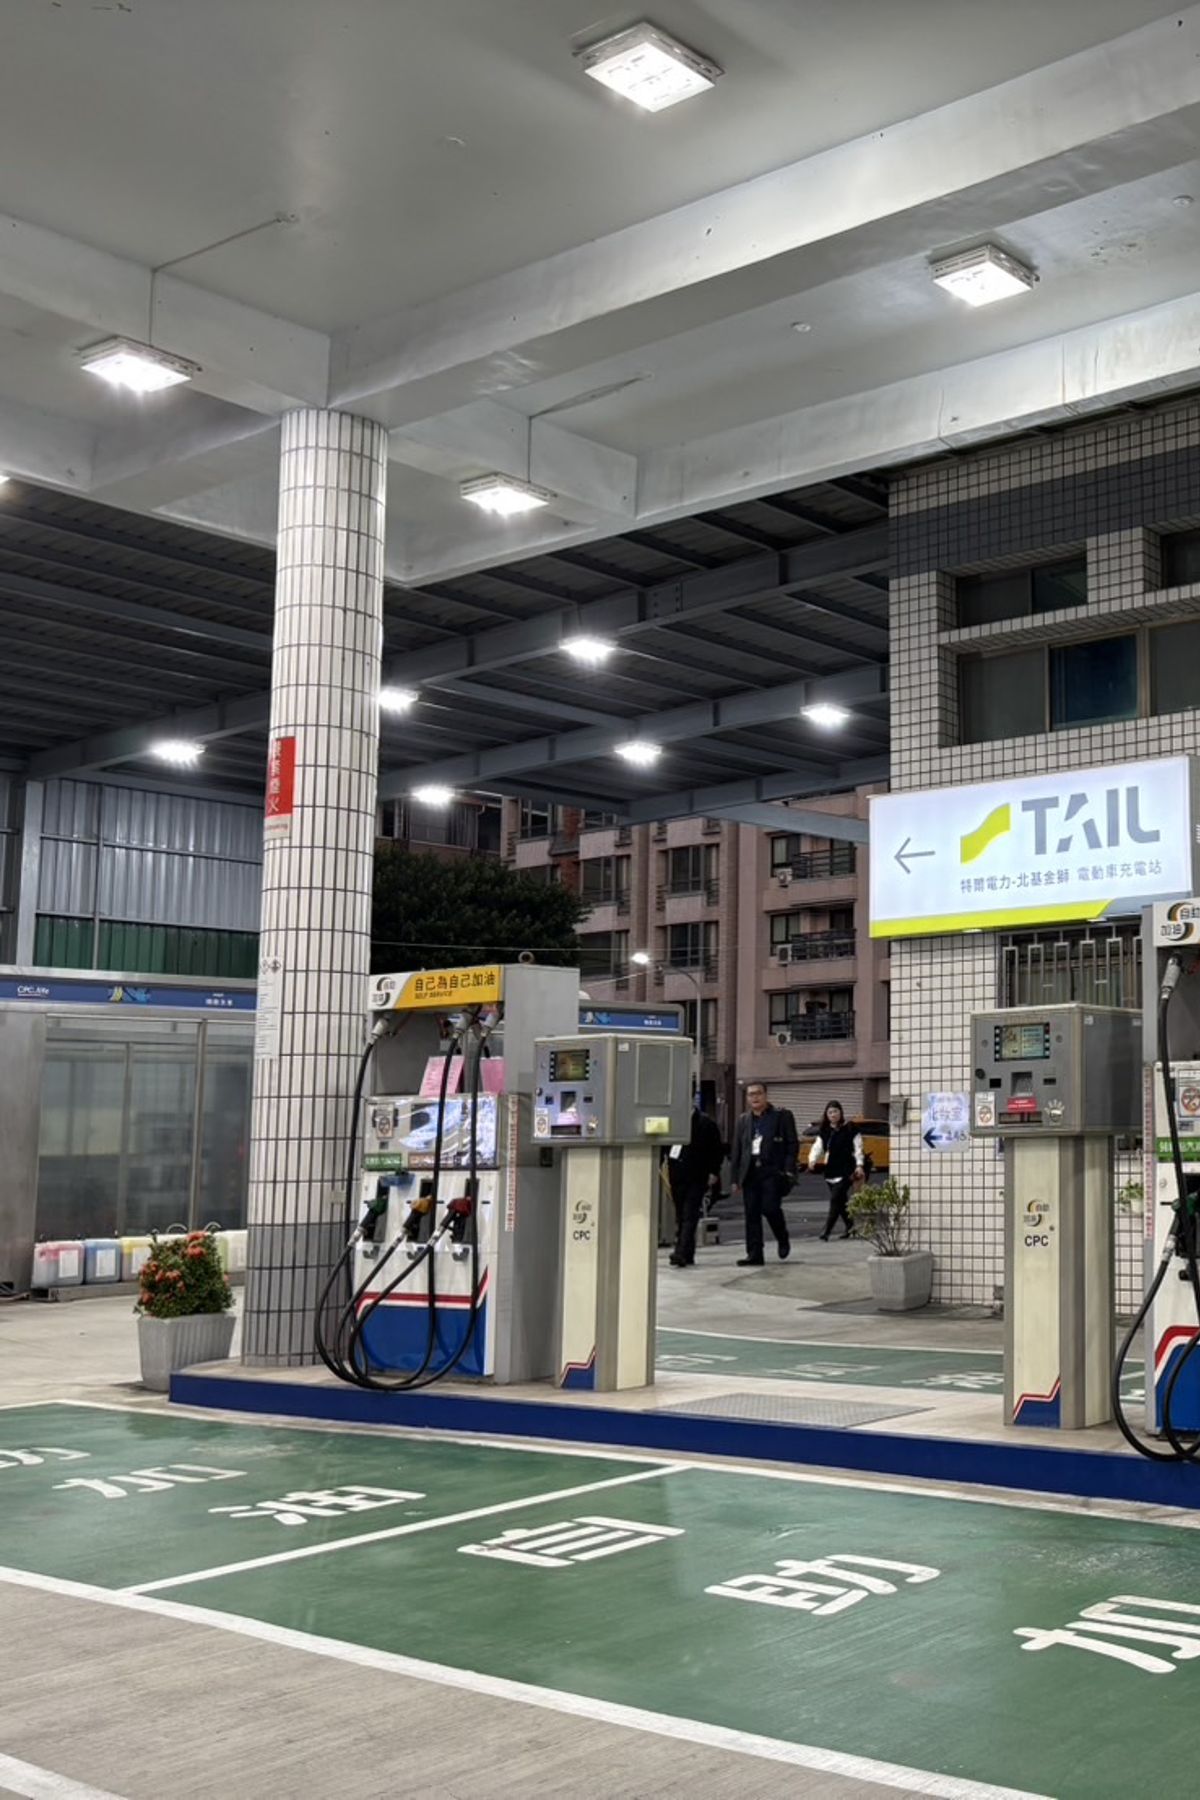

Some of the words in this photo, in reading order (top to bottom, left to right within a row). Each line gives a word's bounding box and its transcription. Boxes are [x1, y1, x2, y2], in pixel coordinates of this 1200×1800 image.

[1021, 786, 1160, 856] TAIL
[1077, 859, 1162, 882] 電動車充電站
[573, 1230, 591, 1241] CPC
[1024, 1234, 1049, 1247] CPC
